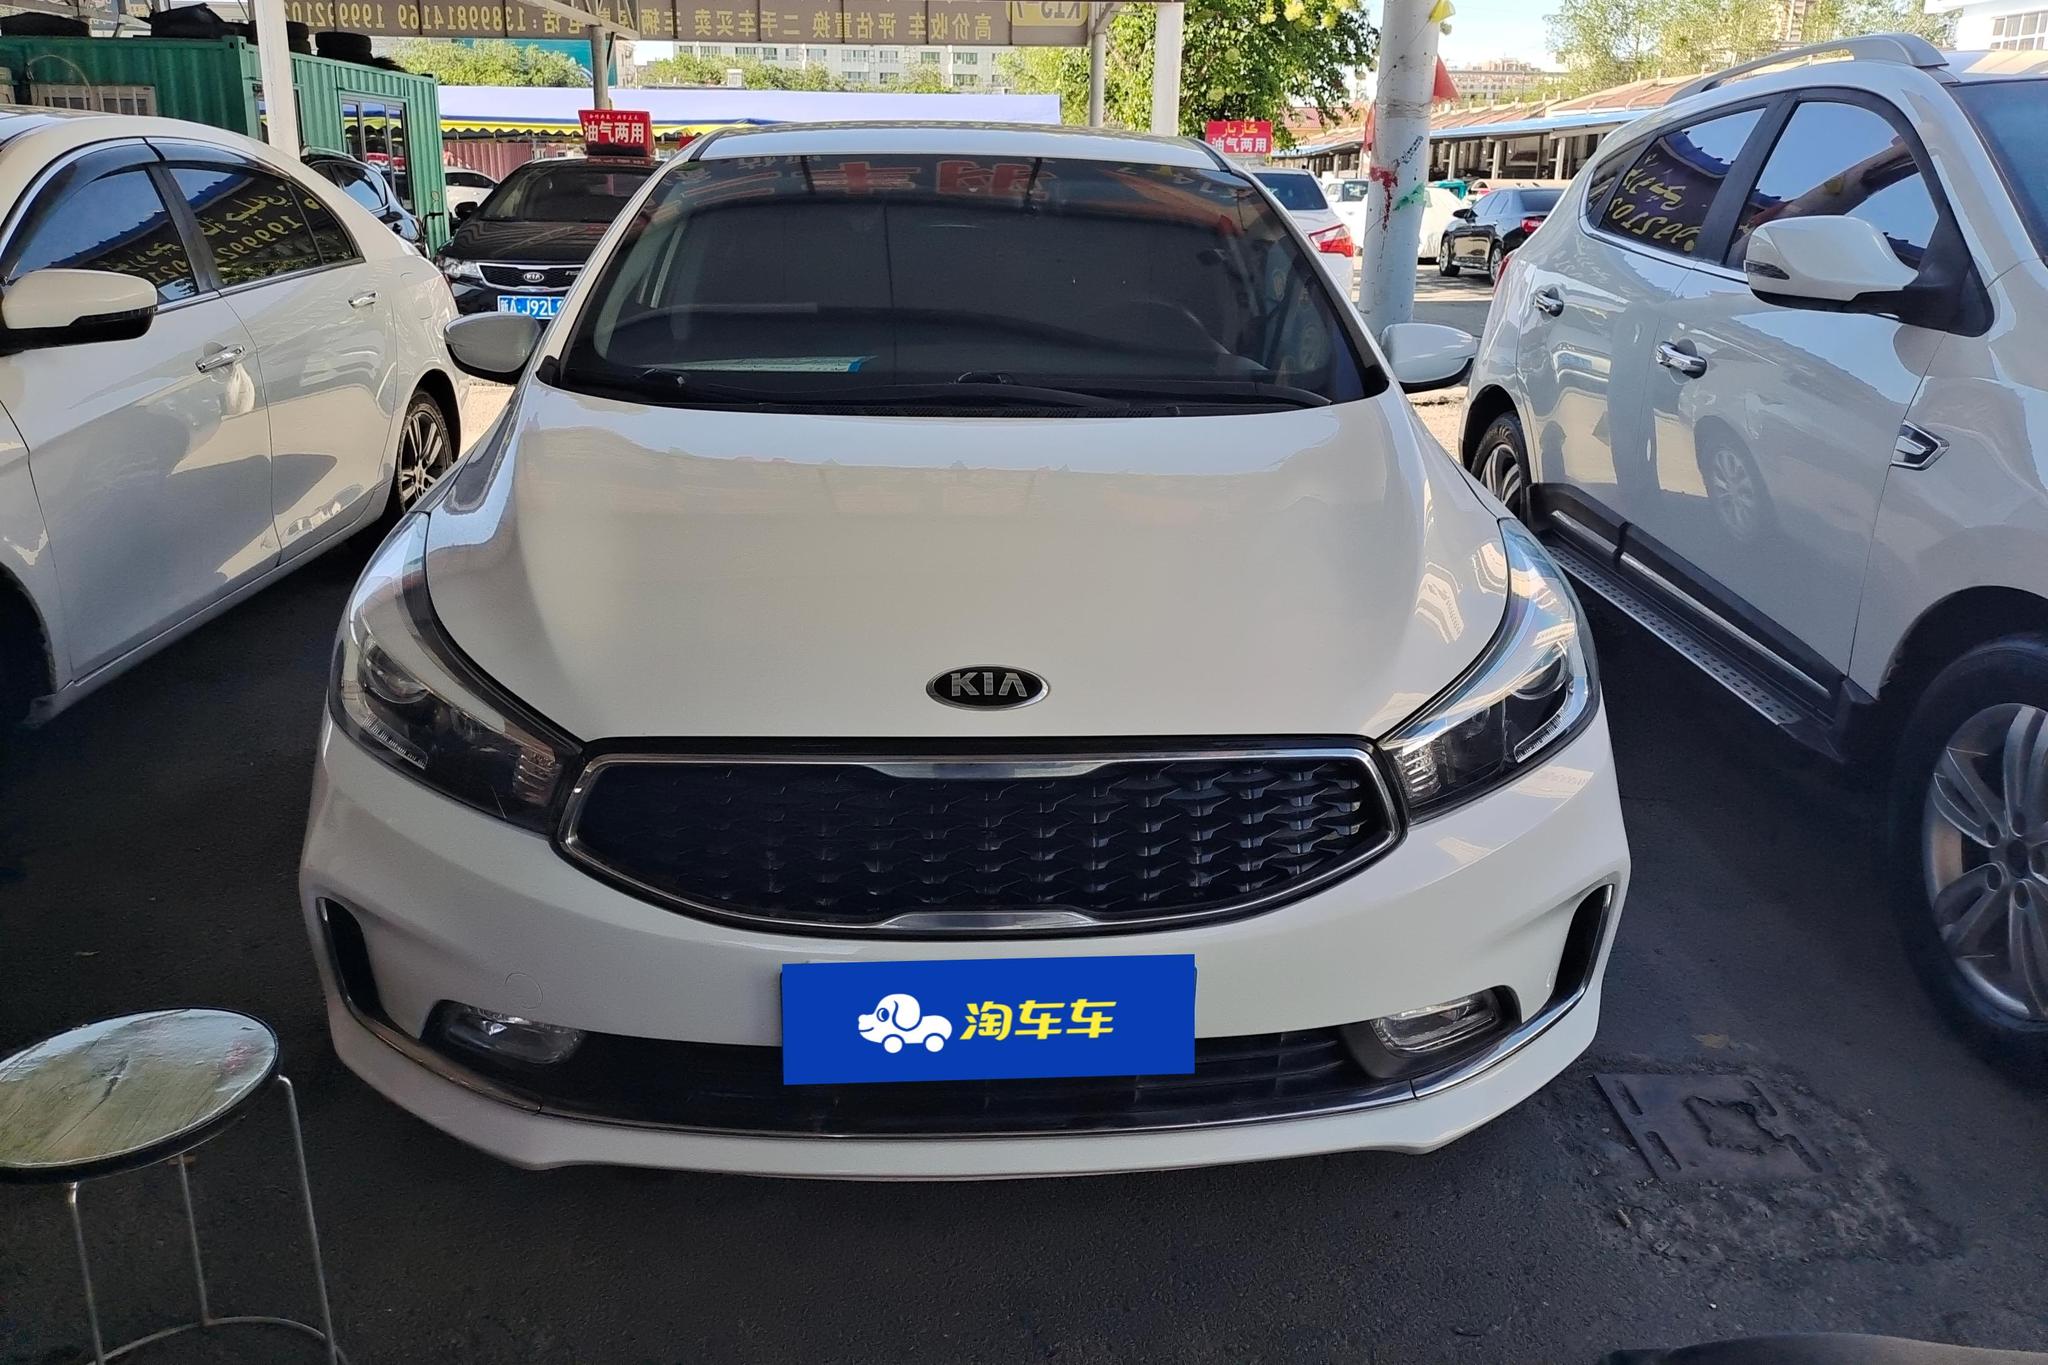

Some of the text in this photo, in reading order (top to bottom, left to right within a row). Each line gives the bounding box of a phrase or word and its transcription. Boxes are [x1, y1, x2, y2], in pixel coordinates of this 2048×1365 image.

[584, 121, 645, 143] 油气两用
[1212, 137, 1267, 153] 油气两用
[950, 671, 1028, 697] KIA
